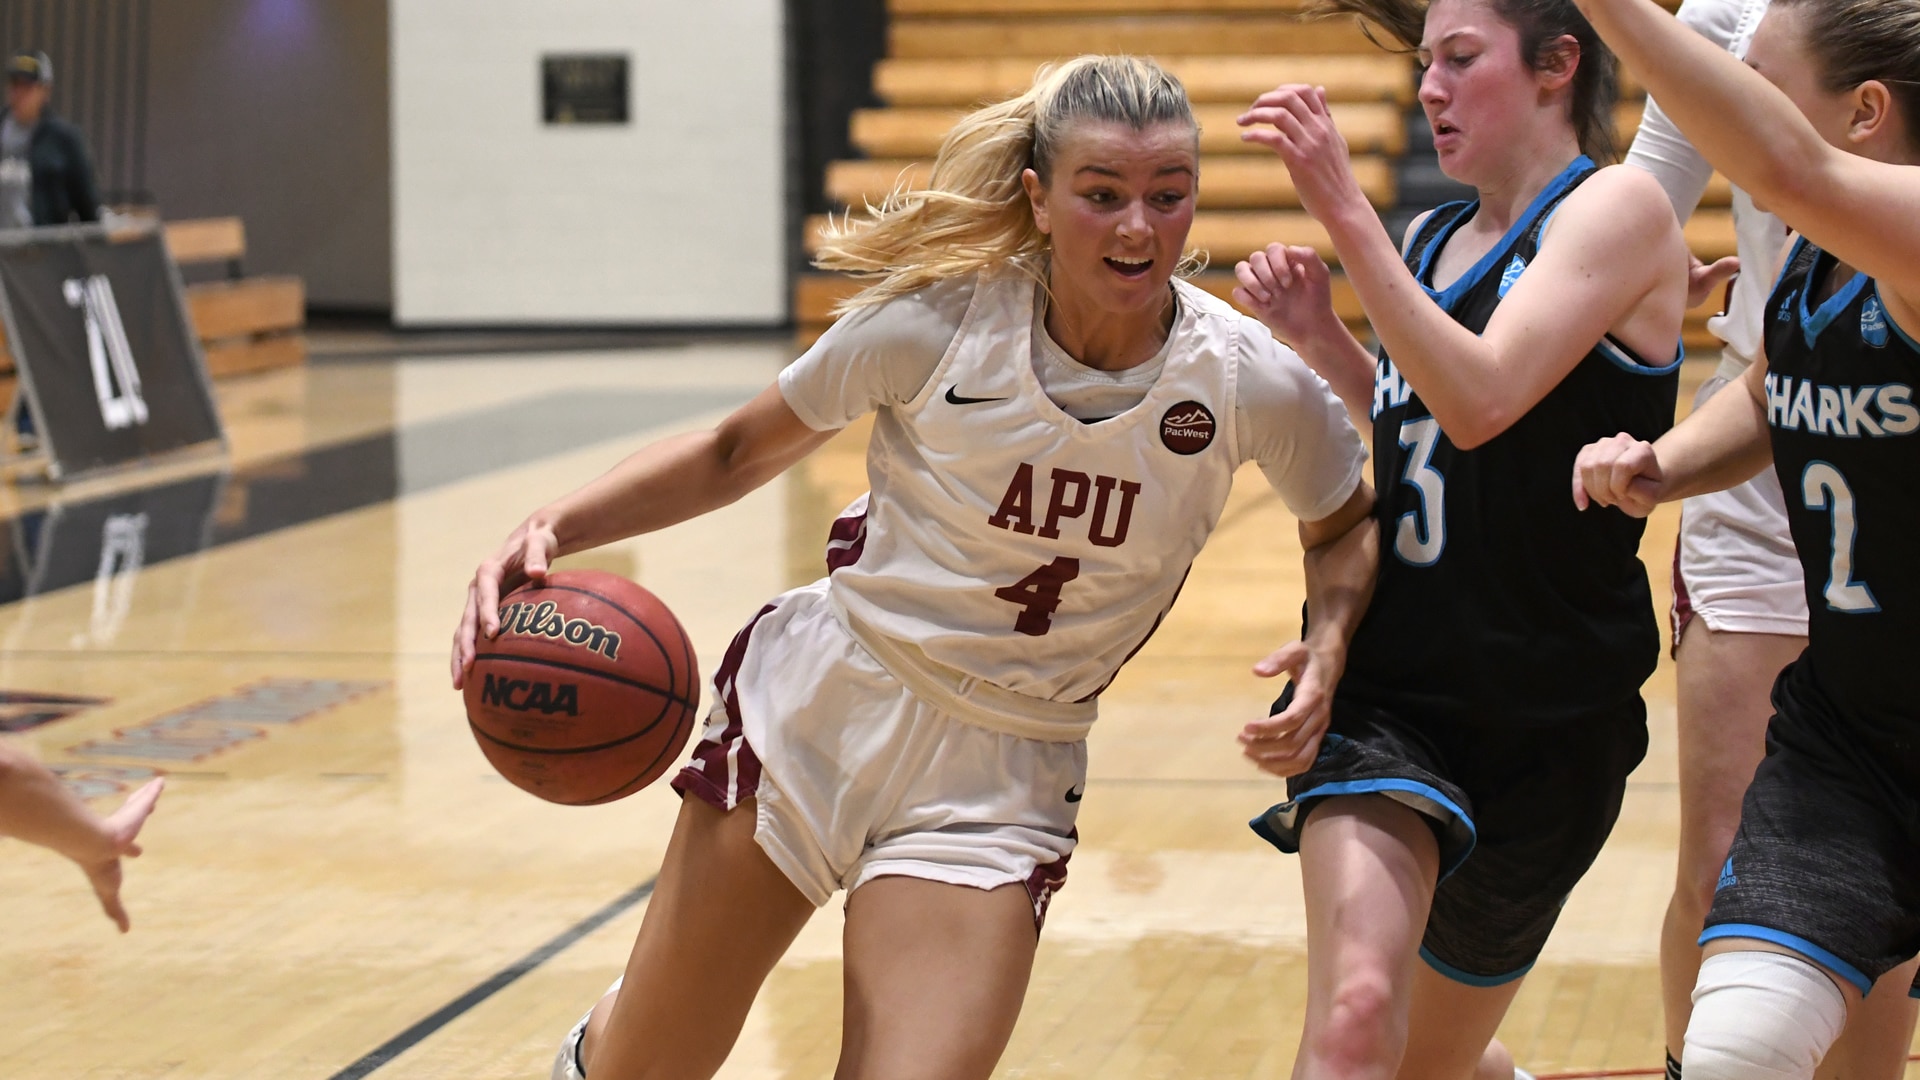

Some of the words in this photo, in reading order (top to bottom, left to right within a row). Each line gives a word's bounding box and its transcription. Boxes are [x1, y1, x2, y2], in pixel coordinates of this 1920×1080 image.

[1165, 427, 1209, 440] PacWest
[987, 462, 1142, 548] APU
[1393, 415, 1447, 568] 3
[1802, 458, 1882, 613] 2
[994, 555, 1080, 637] 4
[481, 673, 579, 717] NCAA
